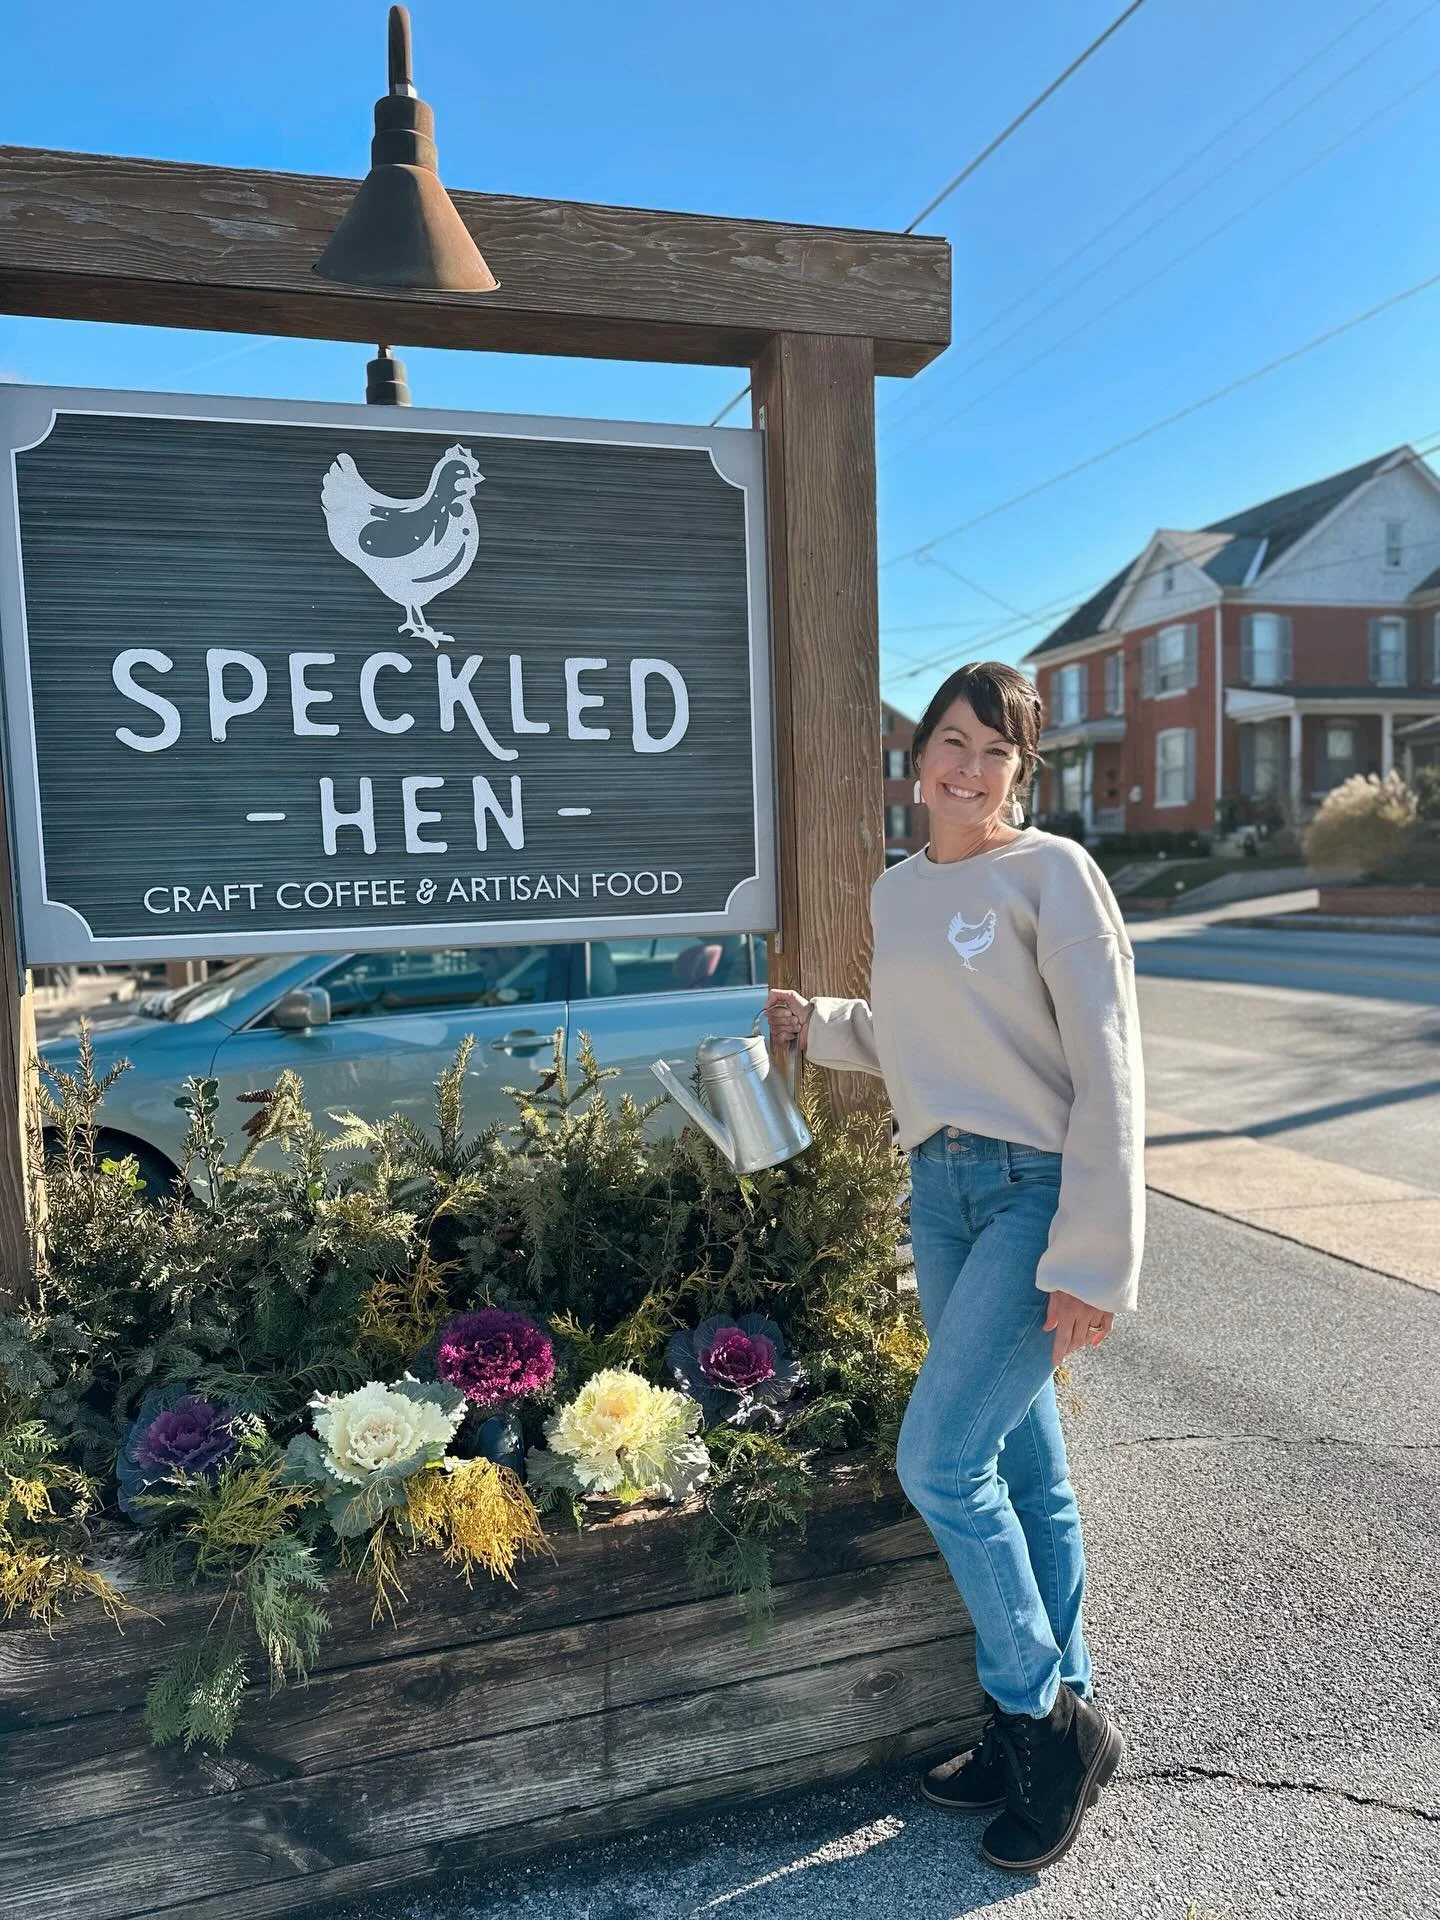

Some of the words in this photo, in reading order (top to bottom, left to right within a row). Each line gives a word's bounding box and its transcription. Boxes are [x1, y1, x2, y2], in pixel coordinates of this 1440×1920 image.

[112, 648, 690, 762] SPECKLED
[319, 774, 525, 856] HEN
[143, 884, 264, 914] CRAFT
[276, 879, 406, 909] COFFEE
[415, 878, 438, 905] &
[446, 874, 580, 903] ARTISAN
[591, 871, 683, 898] FOOD
